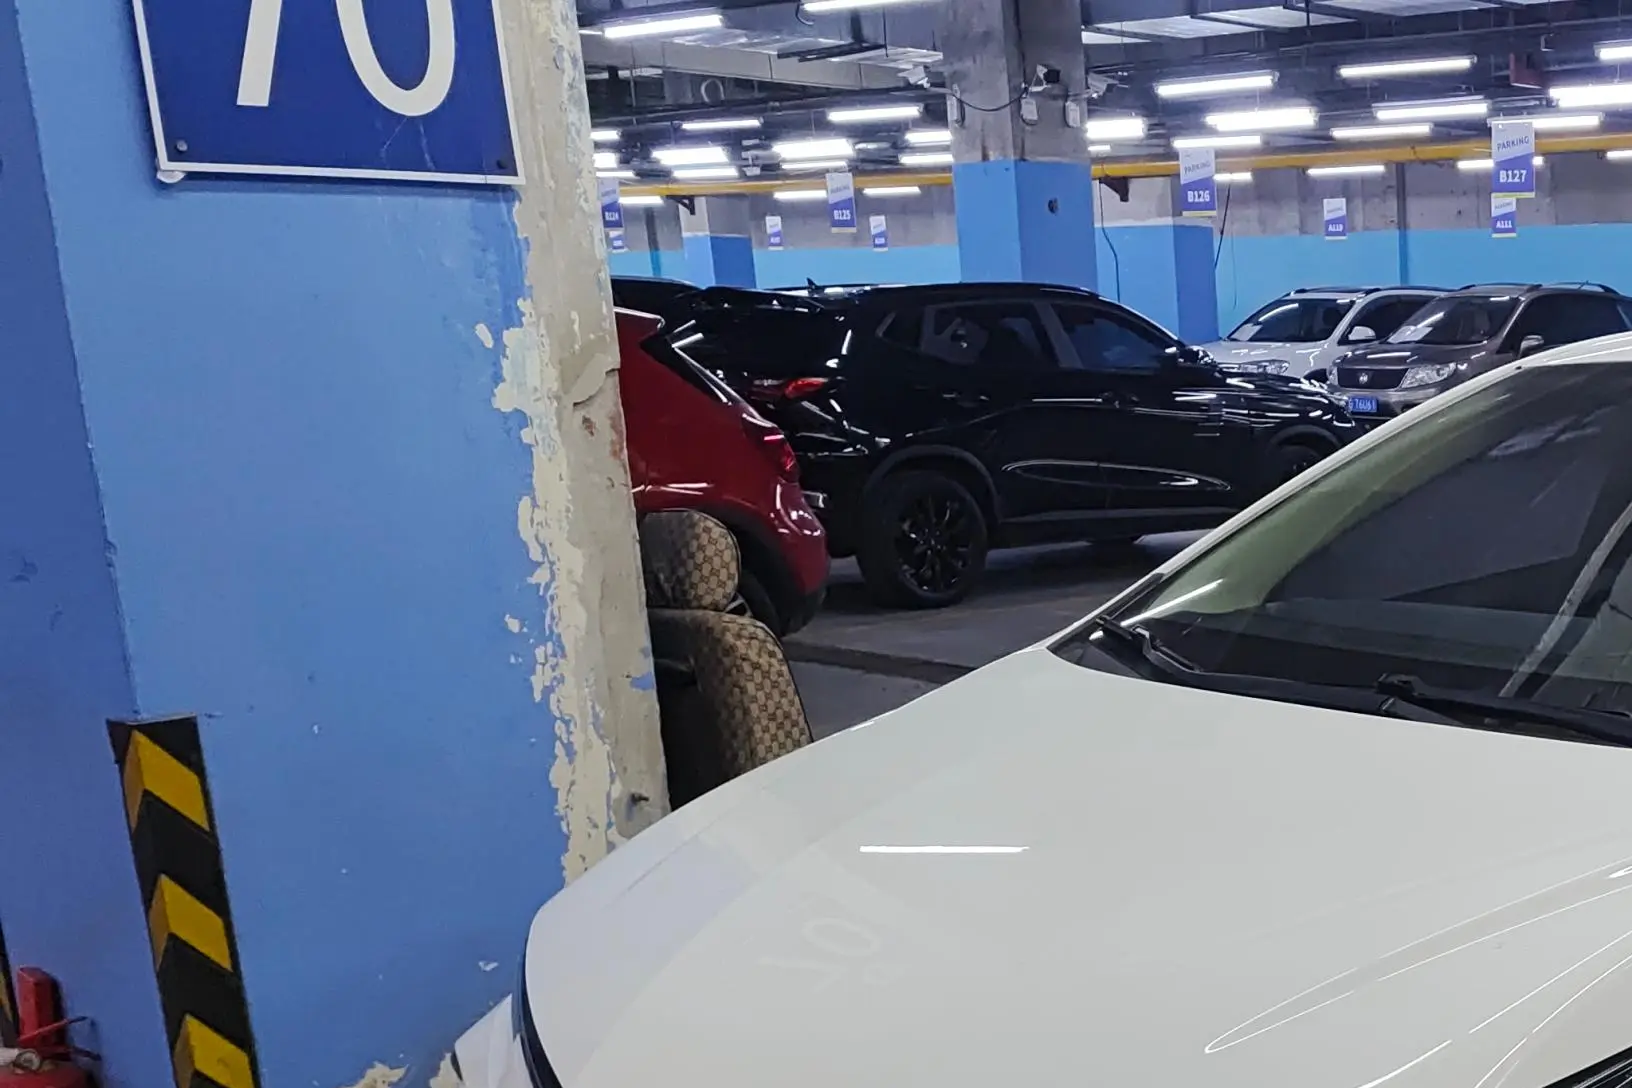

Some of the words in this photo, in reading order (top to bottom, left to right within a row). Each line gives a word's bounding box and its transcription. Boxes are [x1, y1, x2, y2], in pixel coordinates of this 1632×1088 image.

[1496, 136, 1530, 152] PARKING
[1499, 169, 1527, 183] B127
[1187, 190, 1210, 202] B126
